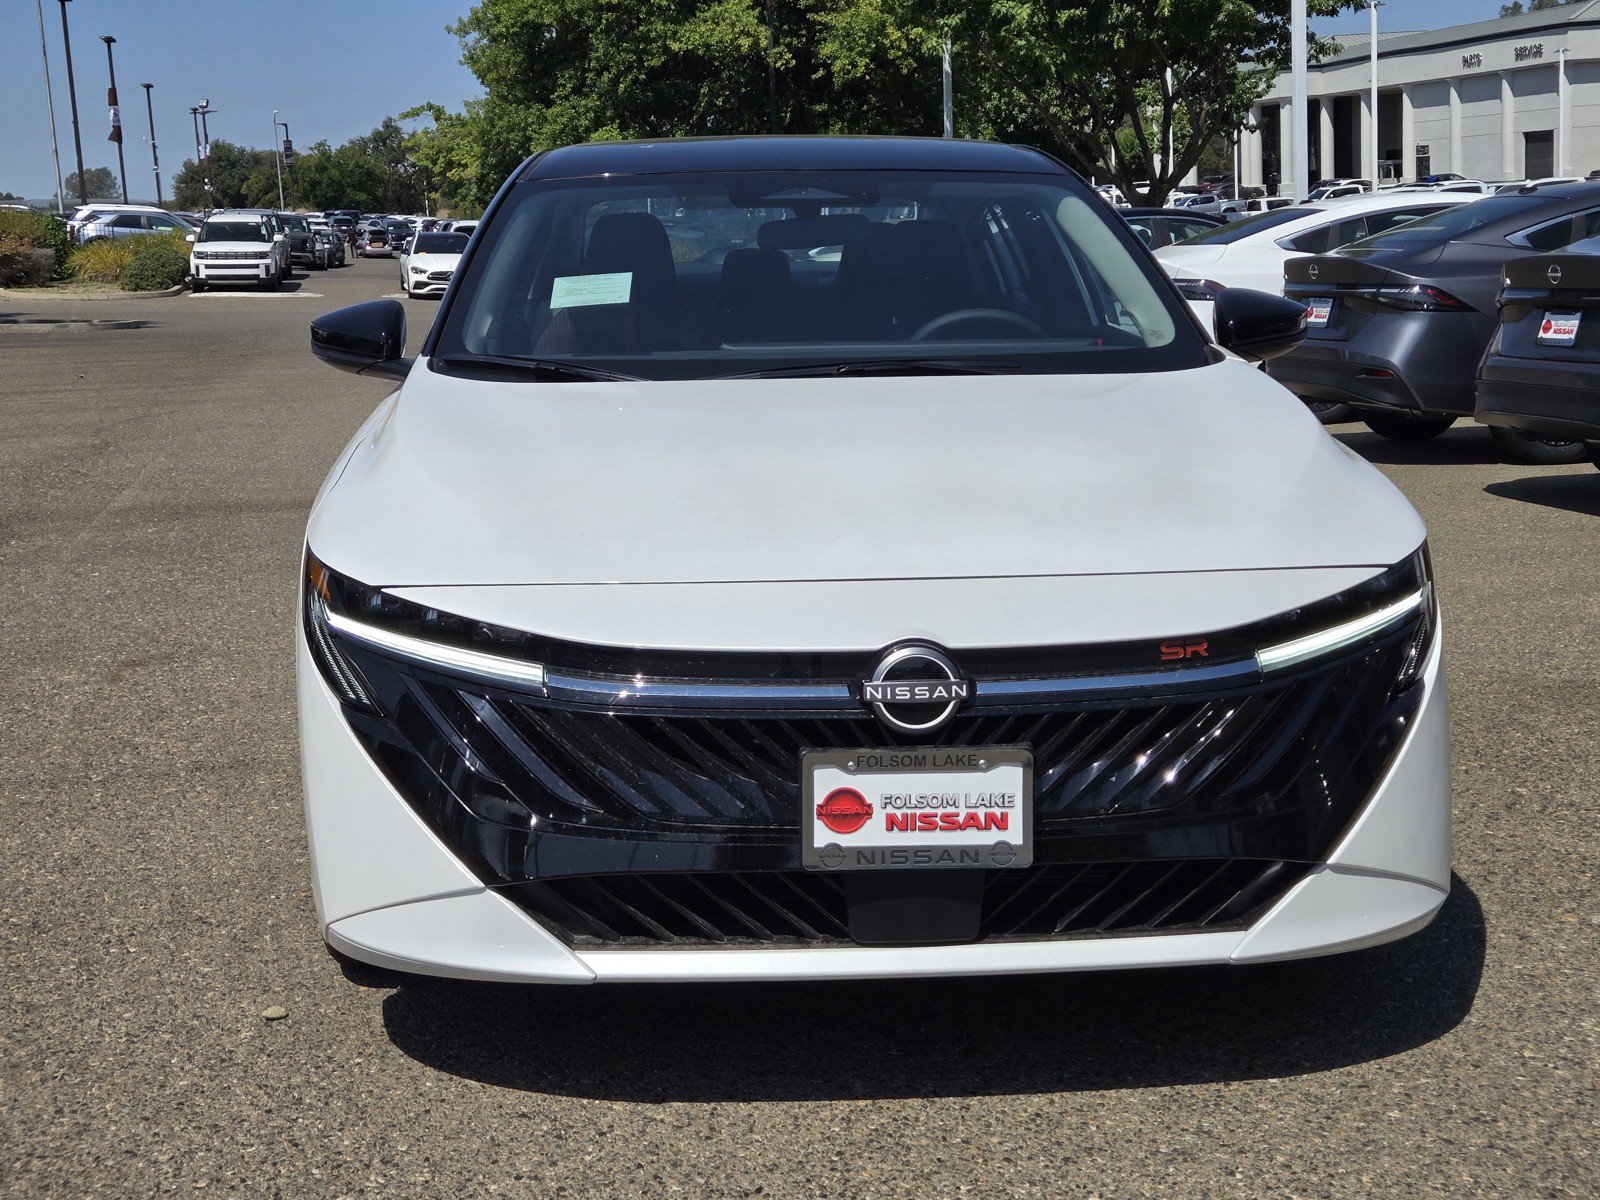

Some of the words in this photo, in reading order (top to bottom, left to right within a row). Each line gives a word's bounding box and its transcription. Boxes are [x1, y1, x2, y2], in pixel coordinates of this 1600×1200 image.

[1514, 43, 1543, 61] SERVICE
[1462, 53, 1482, 69] PARTS
[1160, 639, 1208, 661] SR
[866, 684, 967, 699] NISSAN
[856, 754, 927, 768] FOLSOM
[932, 754, 978, 767] LAKE
[881, 793, 960, 809] FOLSOM
[965, 793, 1016, 808] LAKE
[816, 806, 873, 816] NISSAN
[885, 811, 1009, 832] NISSAN
[856, 849, 980, 866] NISSAN
